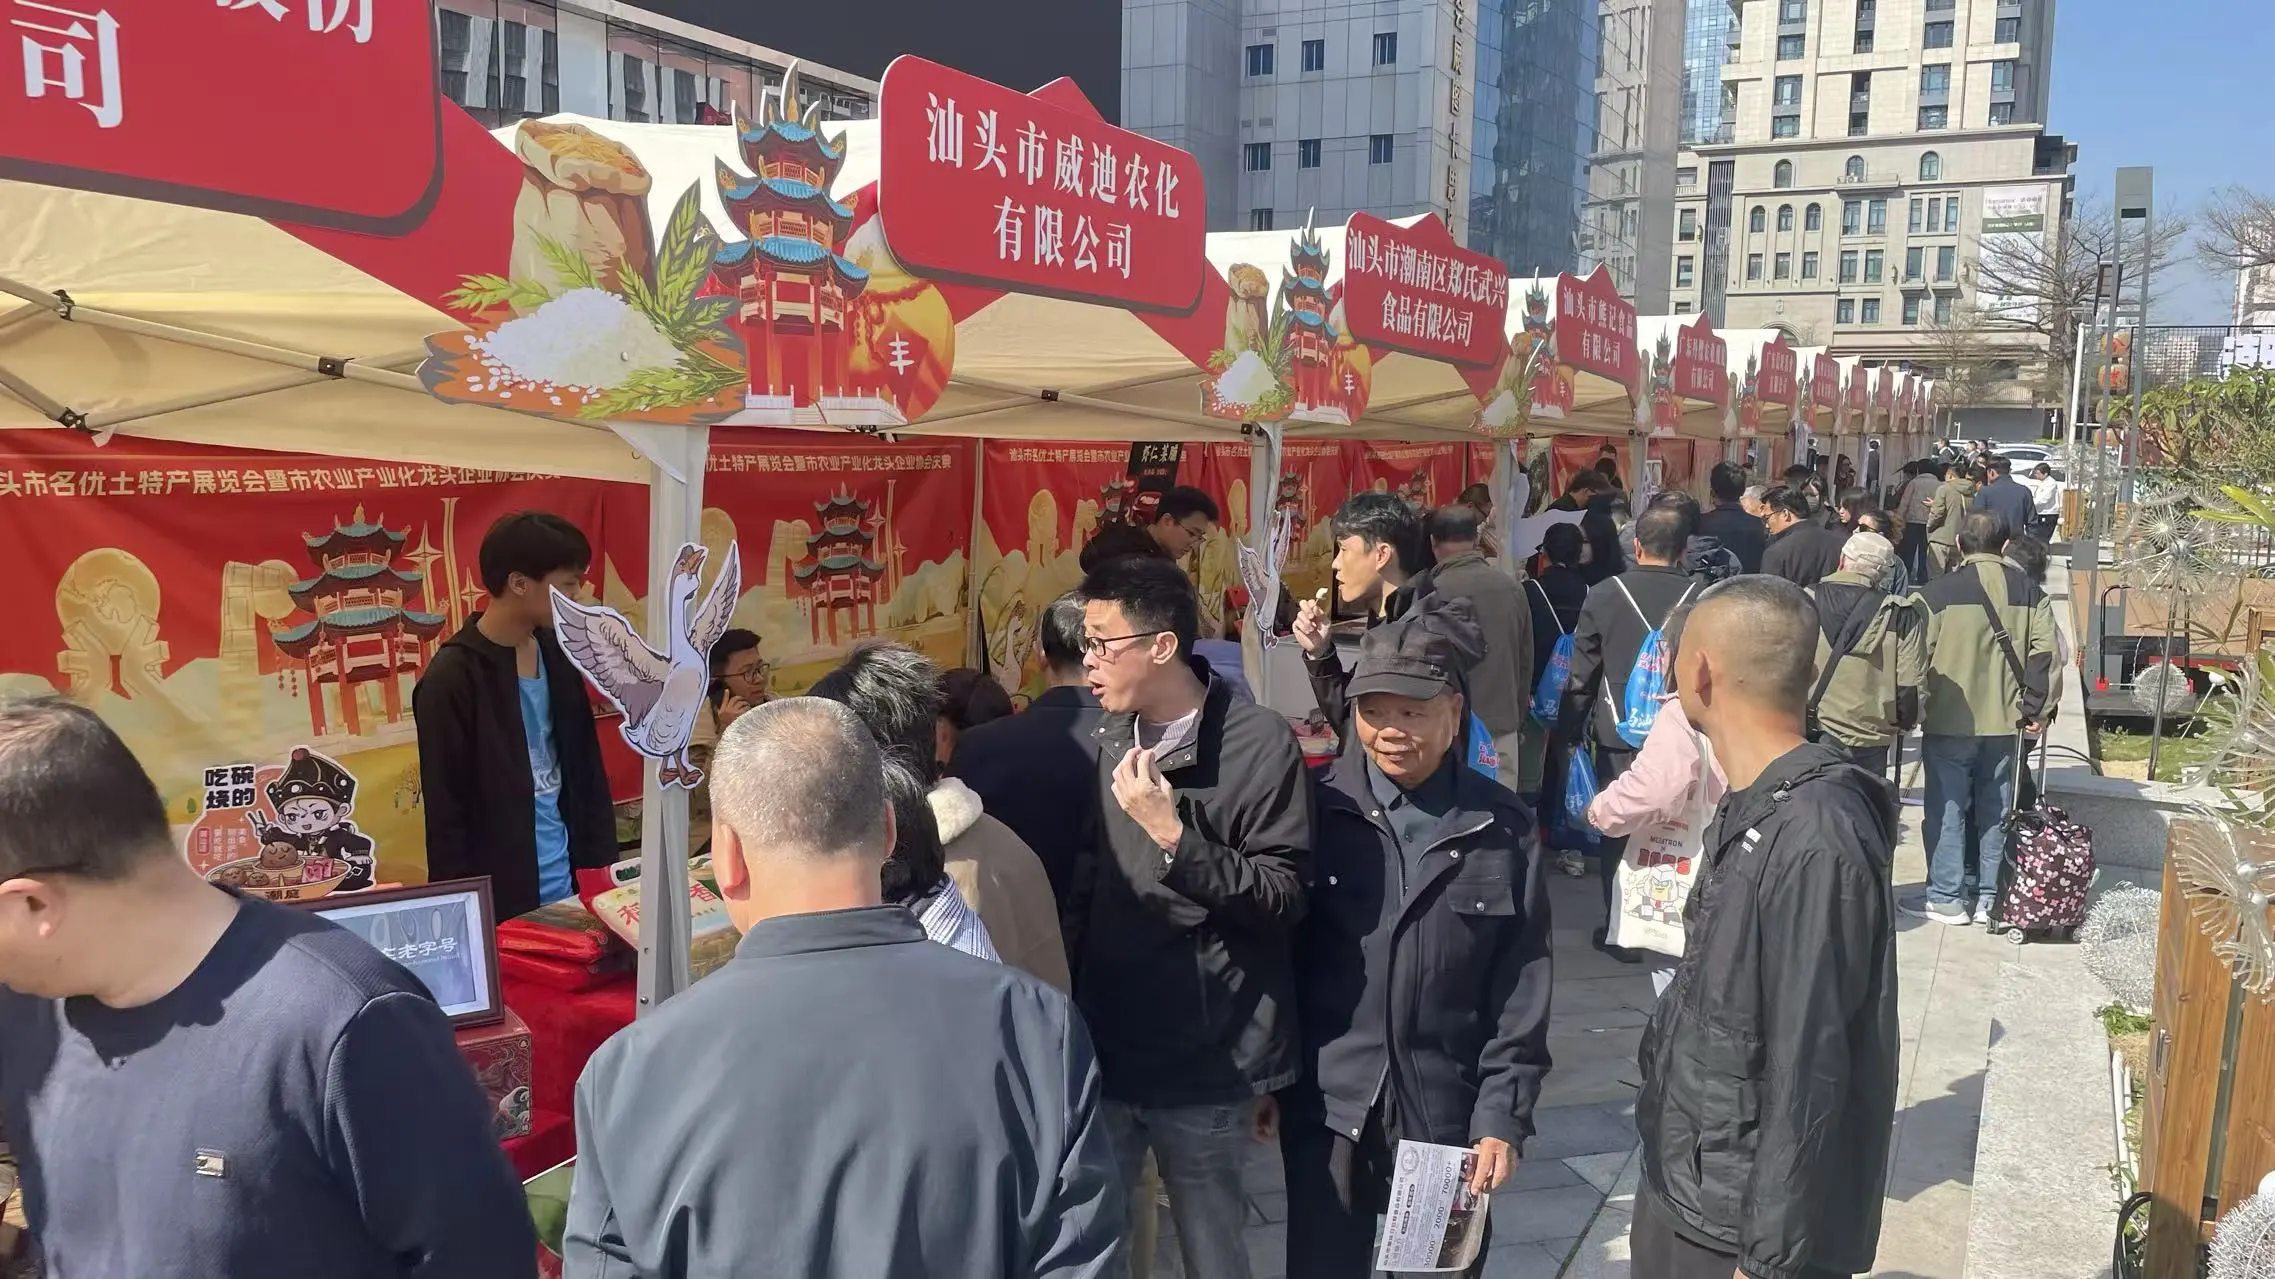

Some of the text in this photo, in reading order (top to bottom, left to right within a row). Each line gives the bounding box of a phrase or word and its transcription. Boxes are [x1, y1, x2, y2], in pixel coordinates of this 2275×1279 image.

[11, 0, 123, 128] 司
[925, 91, 1180, 219] 汕头市威迪农化
[993, 195, 1132, 279] 有限公司
[1348, 228, 1506, 308] 汕头市潮南区郑氏武兴
[1381, 289, 1474, 348] 食品有限公司
[1583, 329, 1620, 368] 有限公司
[889, 332, 915, 376] 丰
[205, 766, 254, 787] 吃碗
